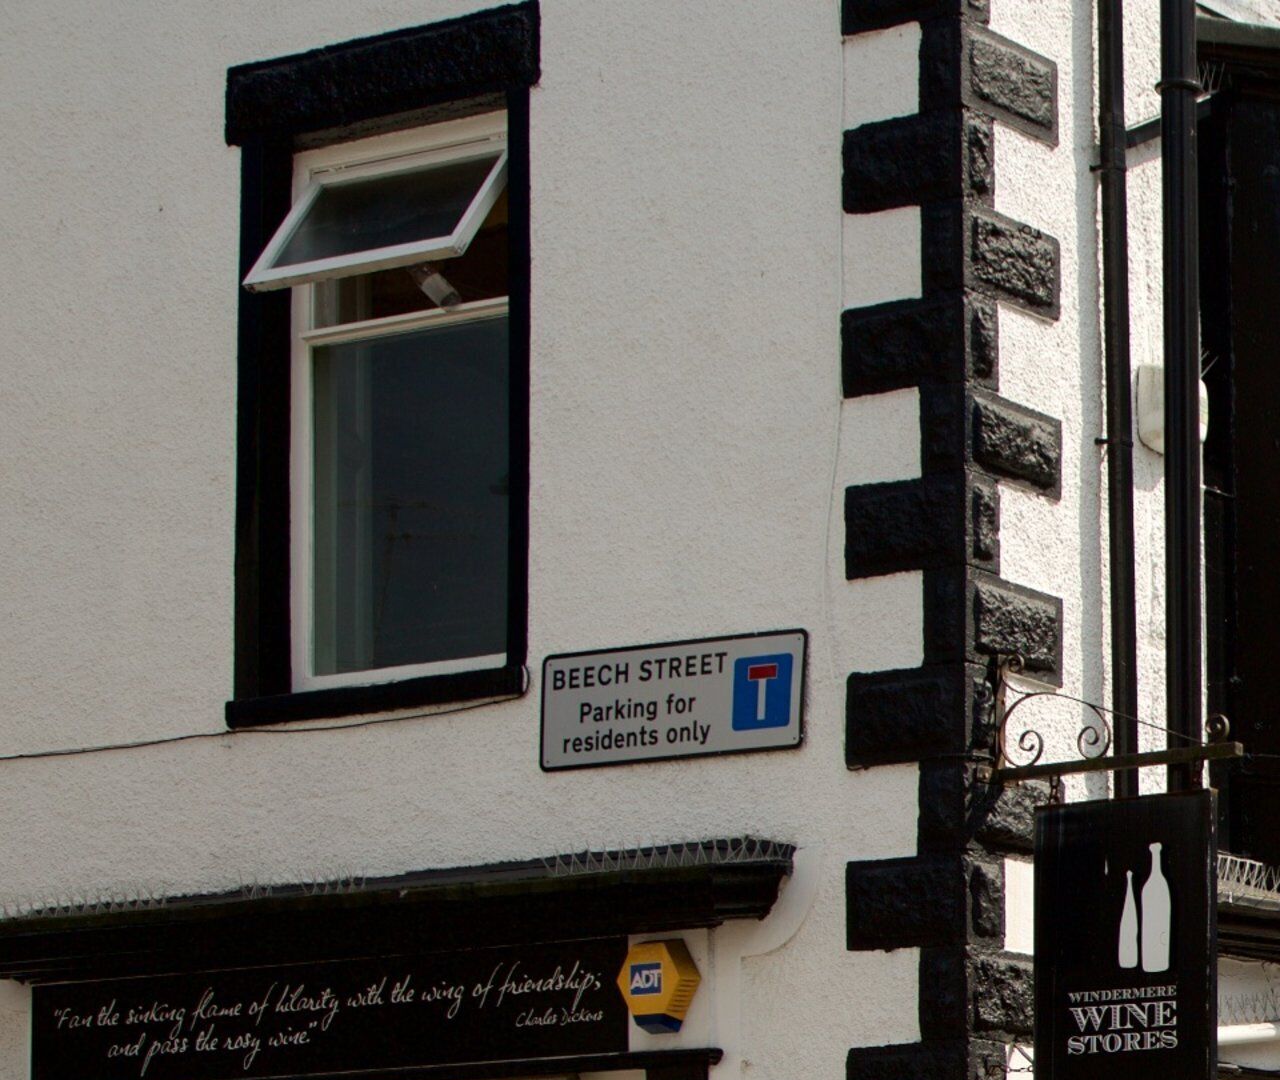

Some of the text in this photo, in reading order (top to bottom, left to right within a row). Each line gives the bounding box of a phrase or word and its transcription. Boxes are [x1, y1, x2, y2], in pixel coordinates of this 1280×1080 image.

[553, 652, 728, 691] BEECH STREET
[580, 694, 696, 723] Parking for
[563, 721, 711, 753] residents only
[630, 968, 662, 991] ADT
[1067, 985, 1177, 1003] WINDERMERE
[98, 999, 118, 1026] the
[126, 1002, 185, 1039] sinking
[191, 987, 242, 1030] flame
[249, 982, 277, 1025] of
[275, 983, 340, 1031] hilarity
[348, 977, 385, 1007] with
[391, 974, 415, 1004] the
[422, 979, 465, 1019] wing
[472, 962, 503, 1008] of
[516, 1008, 604, 1028] Charles Dickens
[1069, 1000, 1177, 1032] WINE
[107, 1032, 146, 1058] and
[141, 1037, 189, 1077] pass
[196, 1023, 217, 1051] the
[226, 1032, 261, 1070] rosy
[1067, 1030, 1178, 1055] STORES
